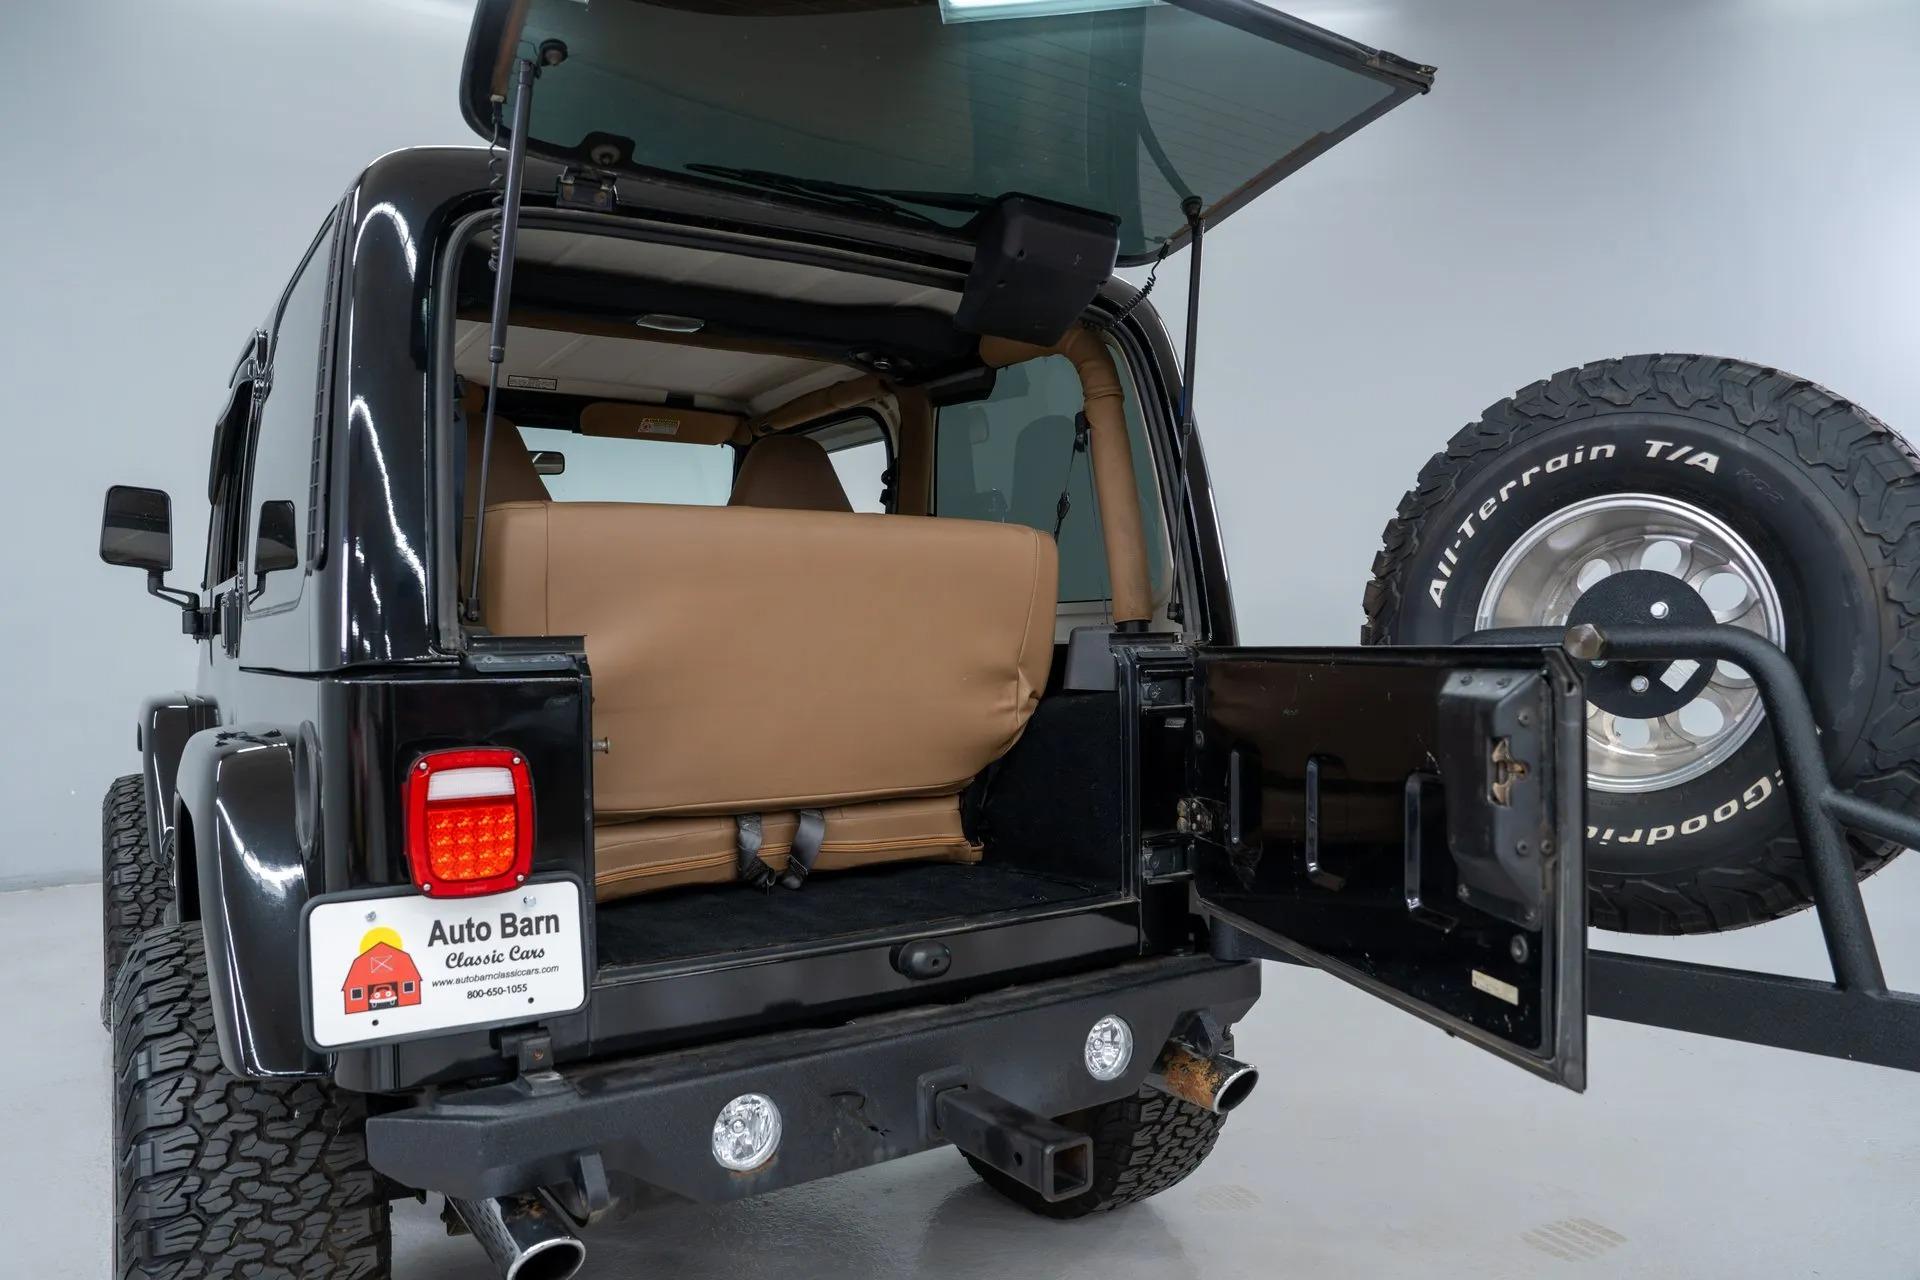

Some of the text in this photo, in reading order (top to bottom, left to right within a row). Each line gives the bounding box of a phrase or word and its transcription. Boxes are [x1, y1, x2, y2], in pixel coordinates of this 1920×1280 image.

[1428, 440, 1720, 608] All-Terrain T/A
[1587, 769, 1784, 846] Goodri
[428, 912, 560, 947] Auto Barn
[445, 946, 545, 968] Classic Cars
[432, 965, 559, 987] www.autobarnclassiccars.com
[467, 984, 527, 999] 800-650-1055
